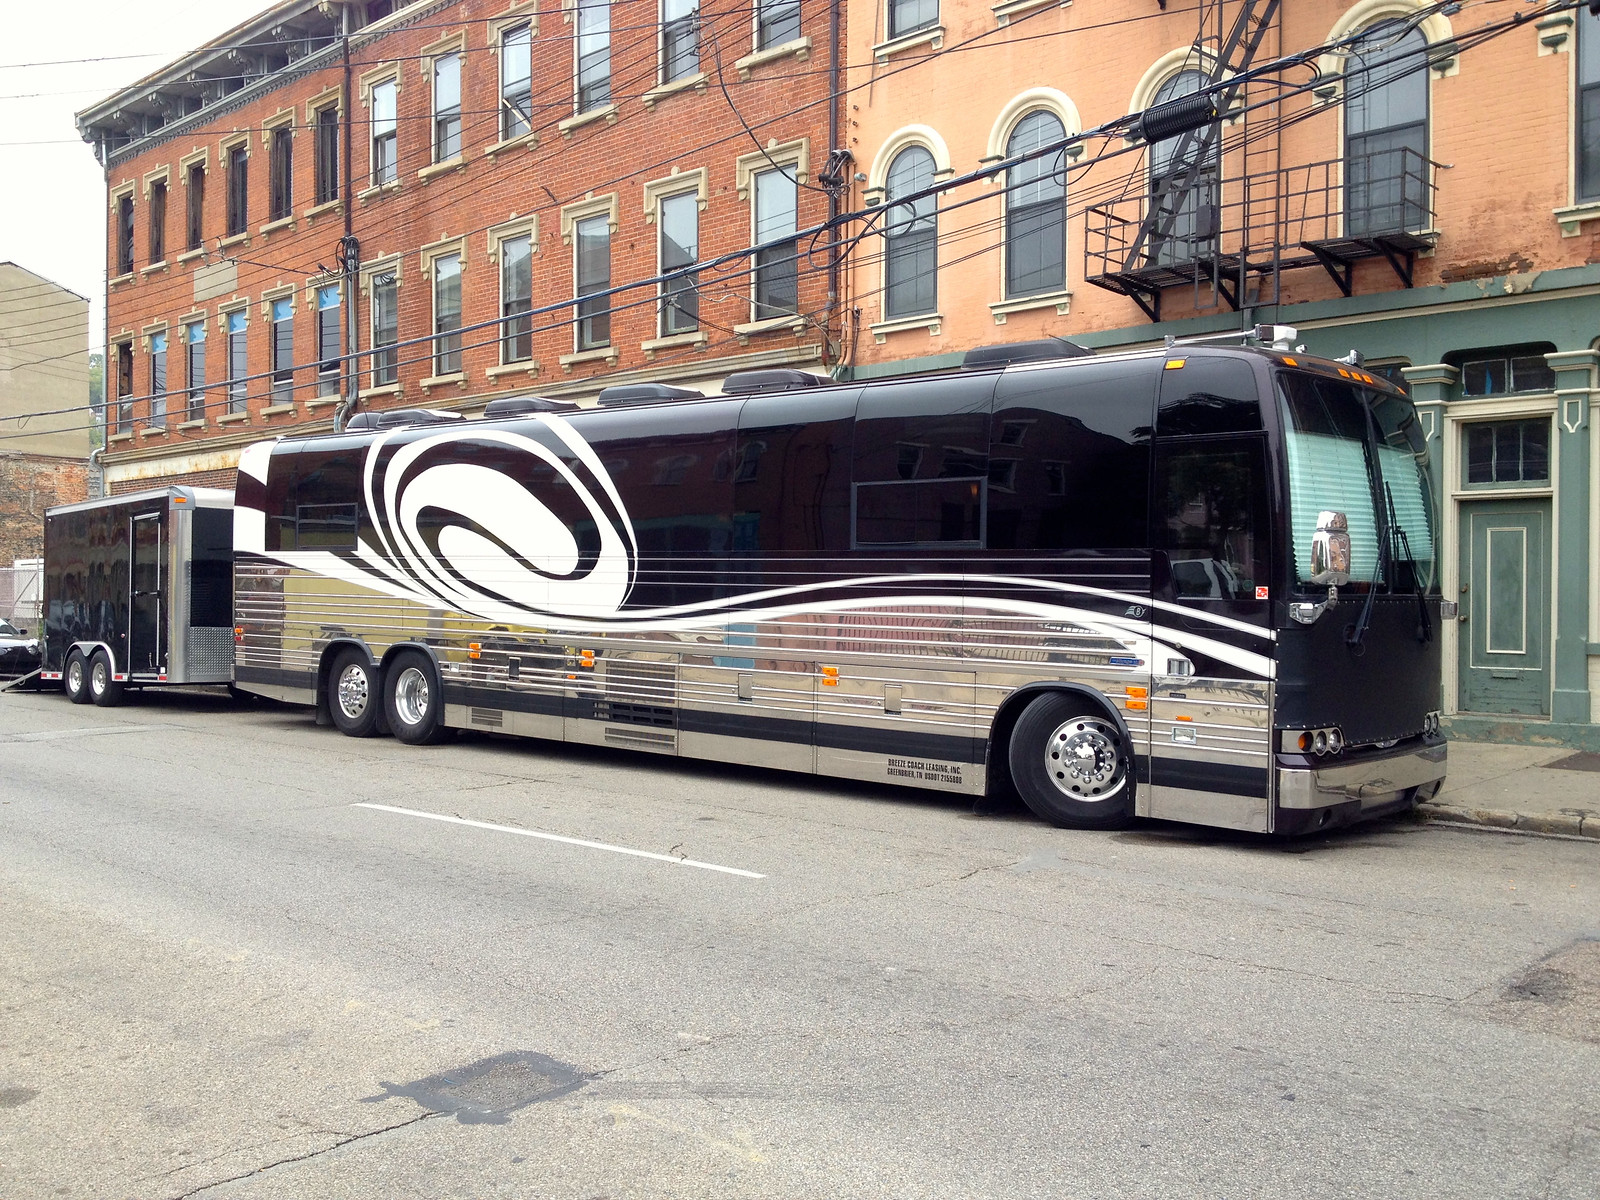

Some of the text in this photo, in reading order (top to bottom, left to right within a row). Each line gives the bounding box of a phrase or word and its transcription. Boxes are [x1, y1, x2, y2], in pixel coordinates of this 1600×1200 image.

[888, 759, 962, 775] BREEZE COACH LEASING, INC.
[887, 768, 916, 779] GREENBRIER,
[916, 771, 923, 779] TN
[925, 773, 940, 781] USDOT
